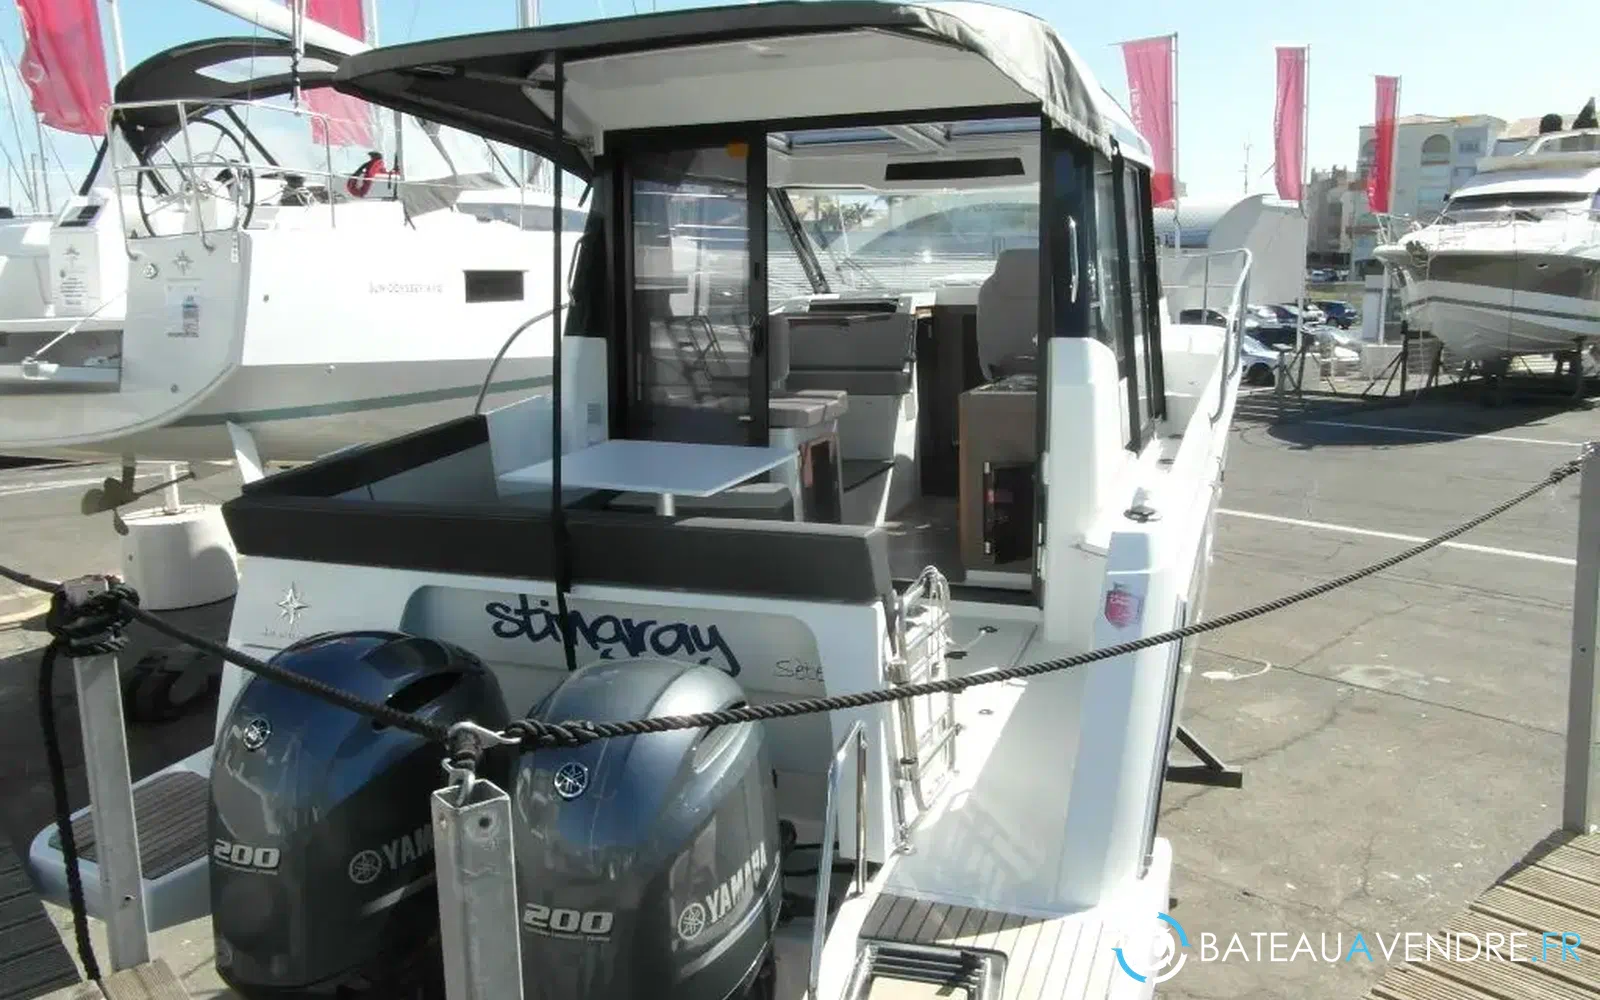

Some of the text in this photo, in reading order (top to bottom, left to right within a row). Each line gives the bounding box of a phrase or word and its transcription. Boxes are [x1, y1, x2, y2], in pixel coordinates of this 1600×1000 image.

[485, 594, 741, 677] stingray
[213, 838, 281, 868] 200
[381, 823, 434, 870] YAM
[705, 841, 768, 923] YAMAHA
[523, 902, 614, 934] 200
